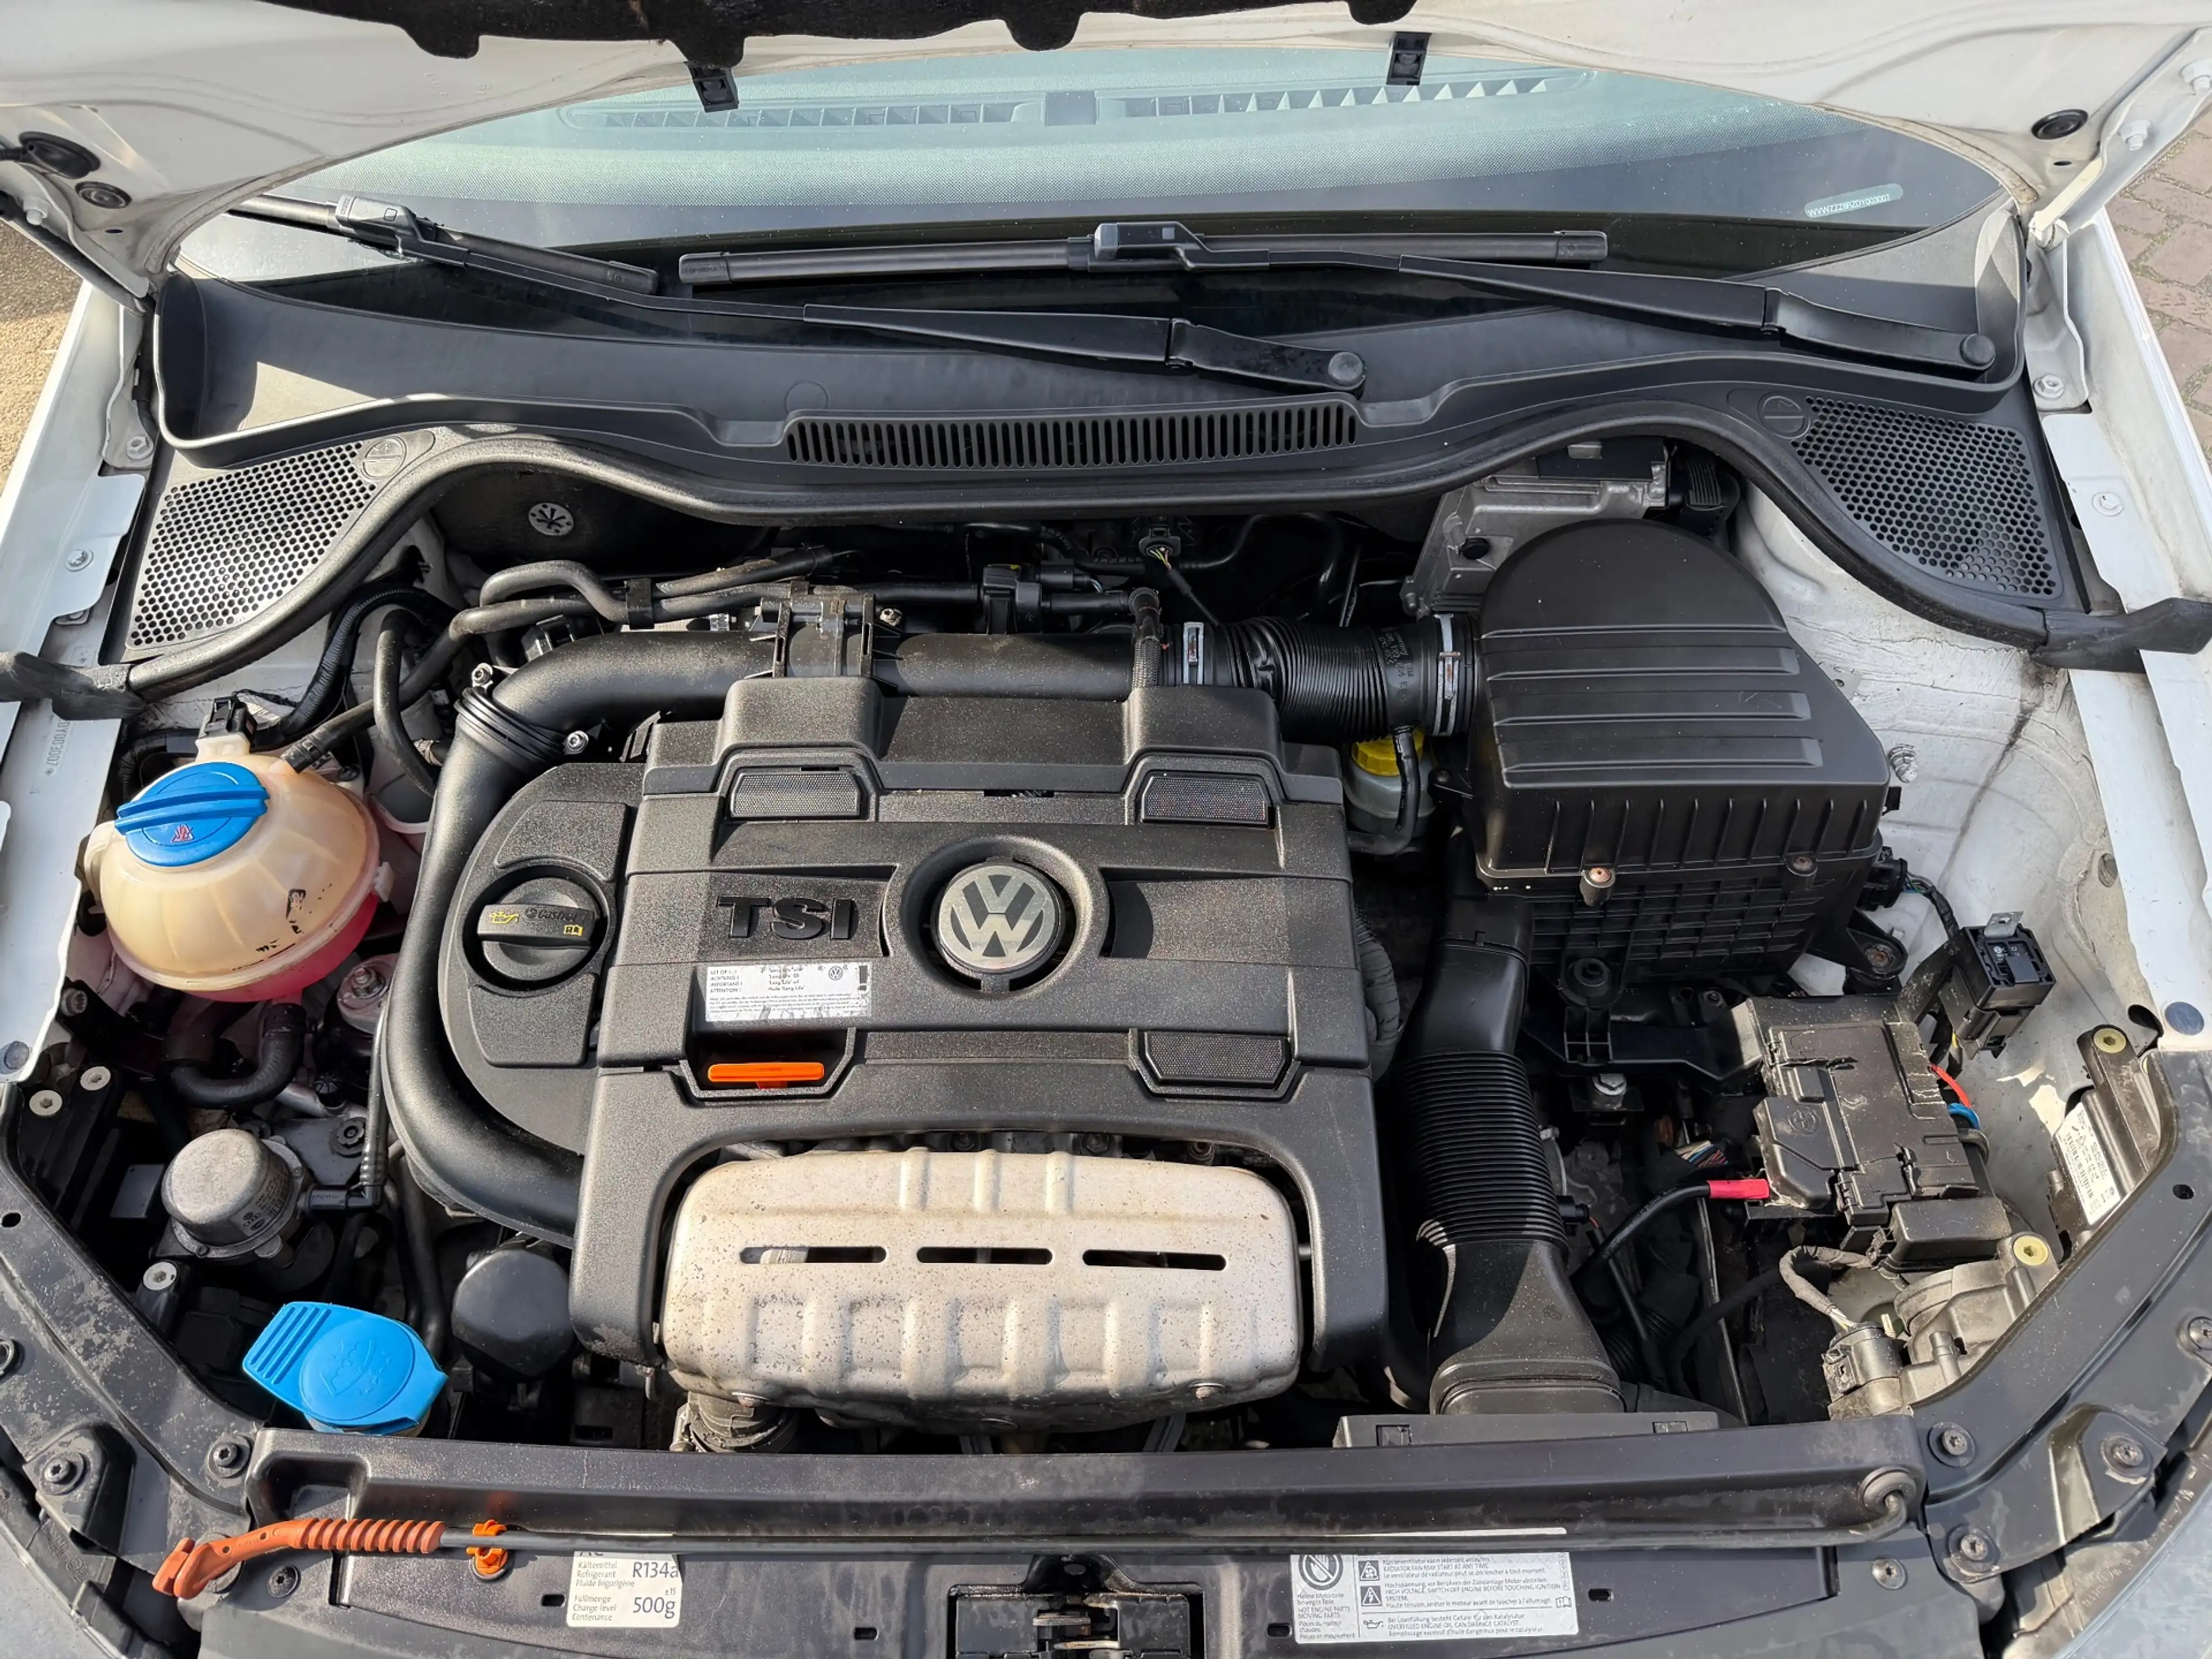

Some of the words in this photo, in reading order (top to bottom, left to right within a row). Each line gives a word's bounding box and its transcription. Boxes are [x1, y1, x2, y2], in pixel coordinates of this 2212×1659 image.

[538, 909, 577, 921] Castrol
[717, 896, 855, 940] TSI
[577, 1570, 615, 1579] Refrigerant
[633, 1562, 679, 1578] R134a
[573, 1604, 598, 1613] Charge
[633, 1597, 676, 1619] 500g
[572, 1613, 613, 1621] Contenance
